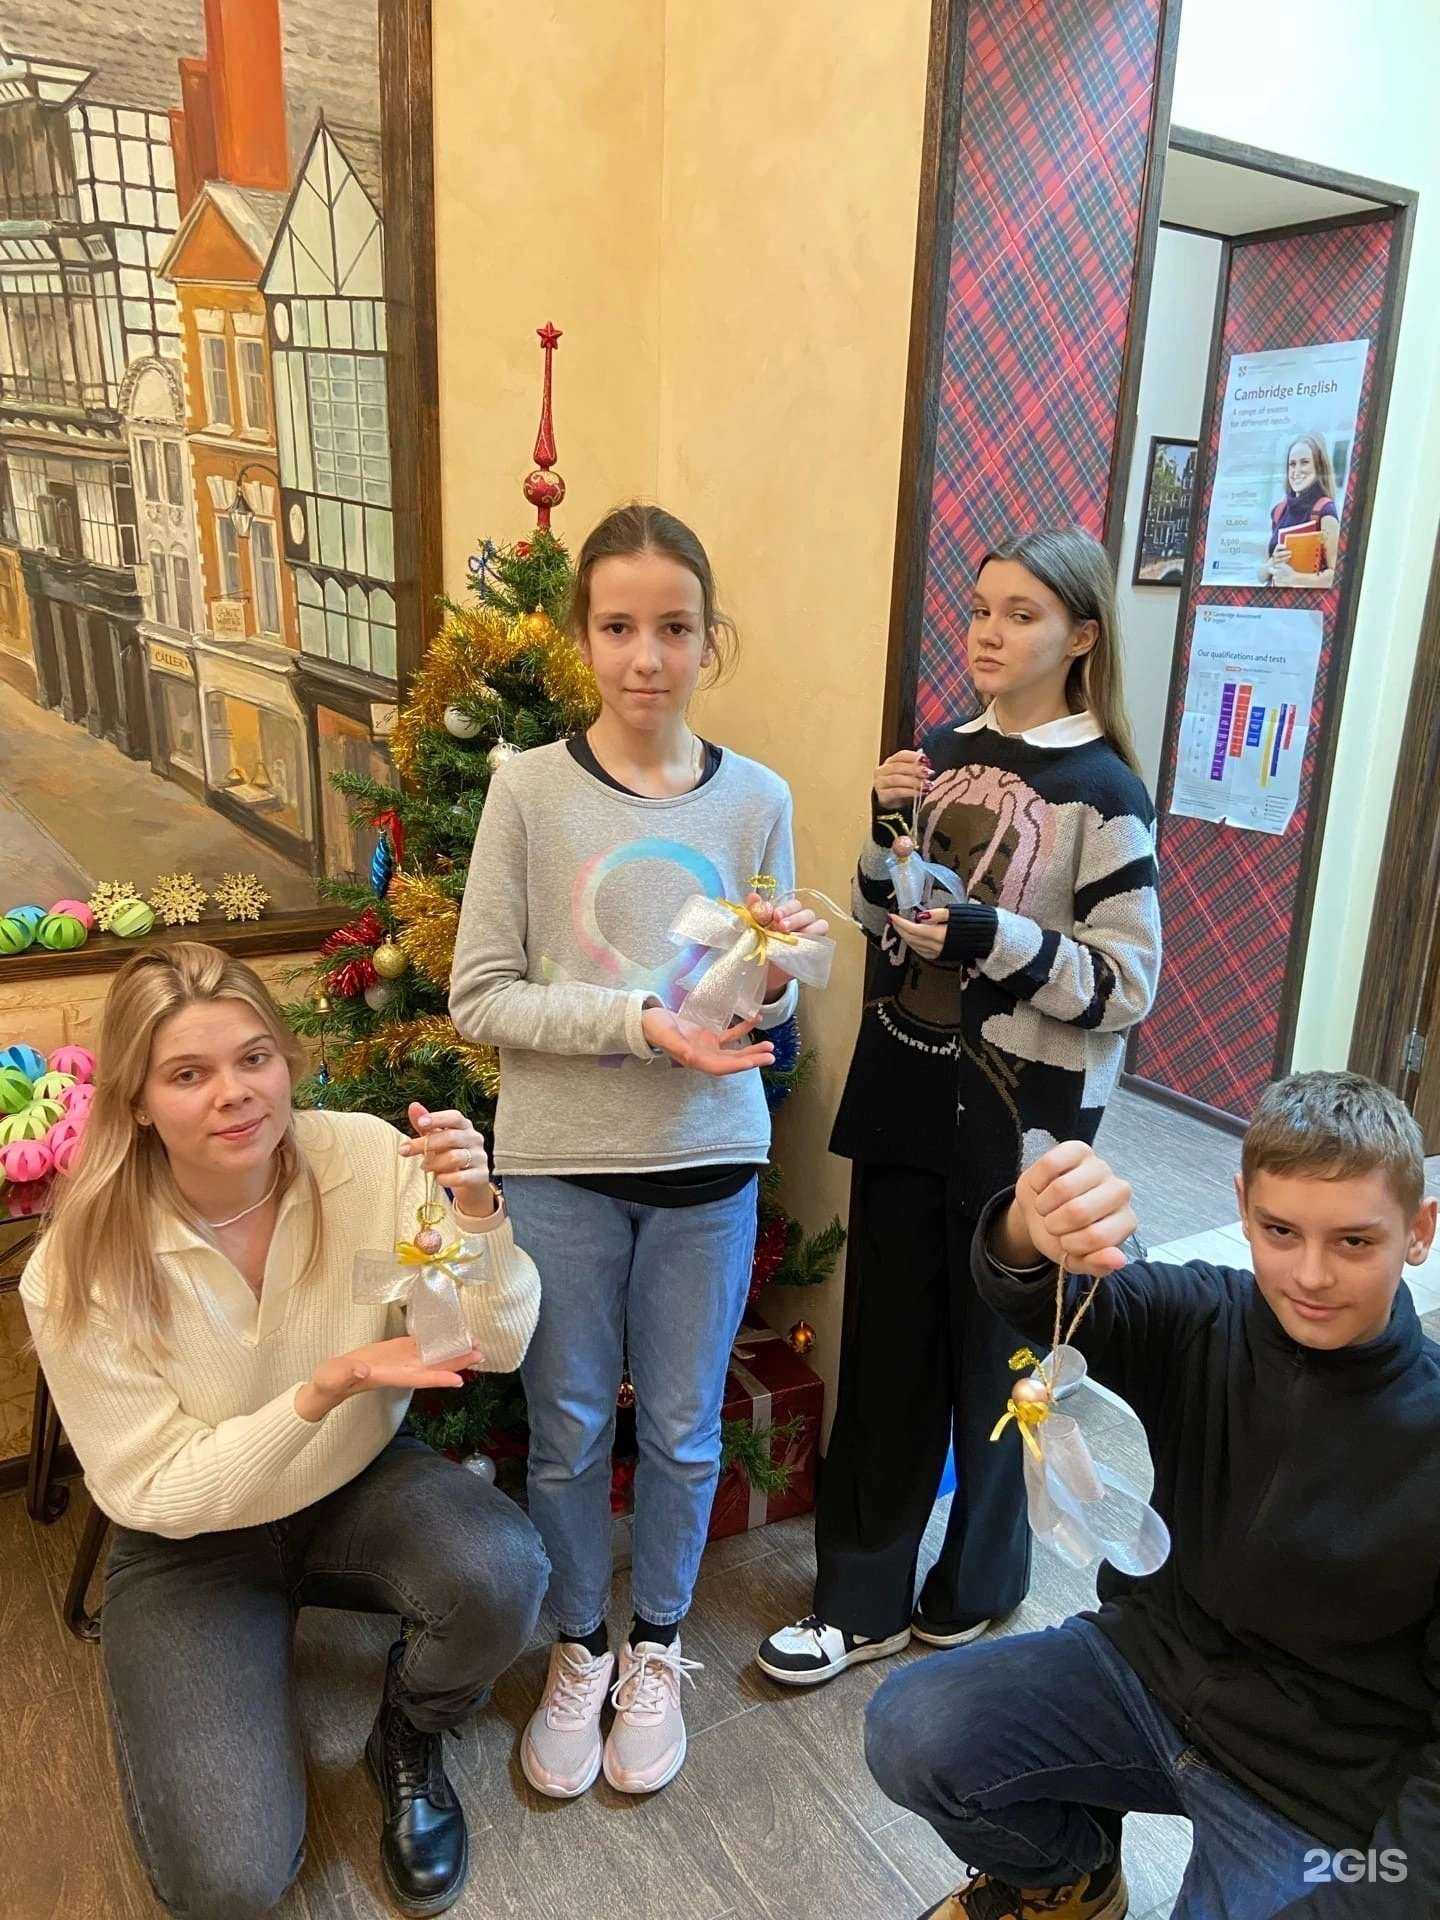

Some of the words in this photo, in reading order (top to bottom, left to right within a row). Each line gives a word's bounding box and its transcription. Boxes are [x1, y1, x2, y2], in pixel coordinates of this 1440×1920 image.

[1234, 386, 1294, 401] Cambridge
[1297, 380, 1338, 398] English
[1198, 649, 1210, 657] Our
[1211, 650, 1254, 661] qualifications
[1255, 653, 1269, 662] and
[1269, 655, 1286, 663] tests
